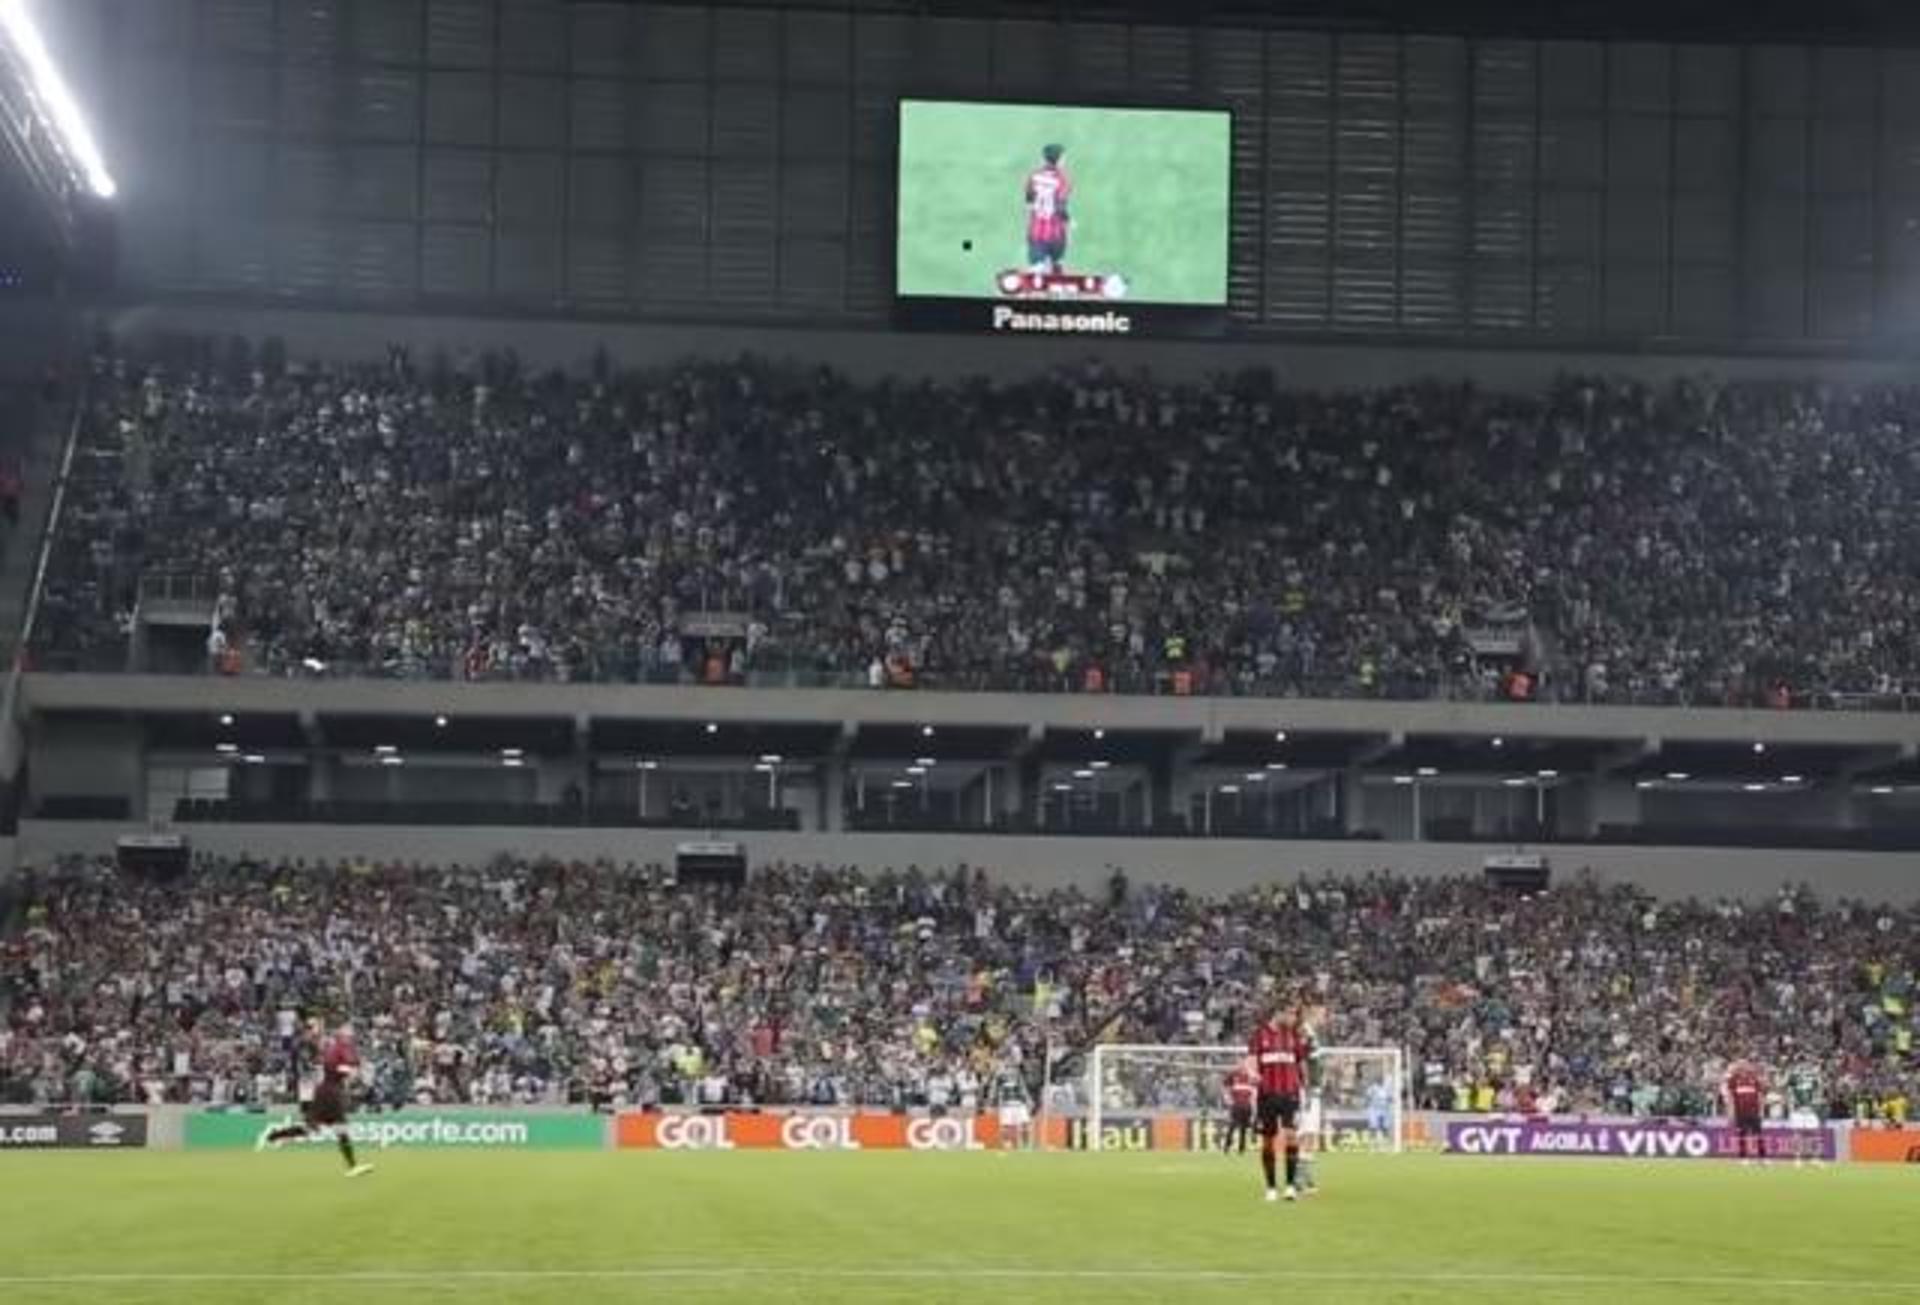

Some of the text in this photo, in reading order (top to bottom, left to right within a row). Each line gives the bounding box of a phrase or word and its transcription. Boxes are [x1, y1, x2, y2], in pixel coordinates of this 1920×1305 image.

[992, 306, 1130, 331] Panasonic
[656, 1115, 735, 1148] GOL
[782, 1116, 860, 1148] GOL
[908, 1117, 985, 1149] GOL
[1459, 1127, 1521, 1153] GVT
[1531, 1132, 1594, 1151] AGORA
[1616, 1131, 1709, 1155] VIVO
